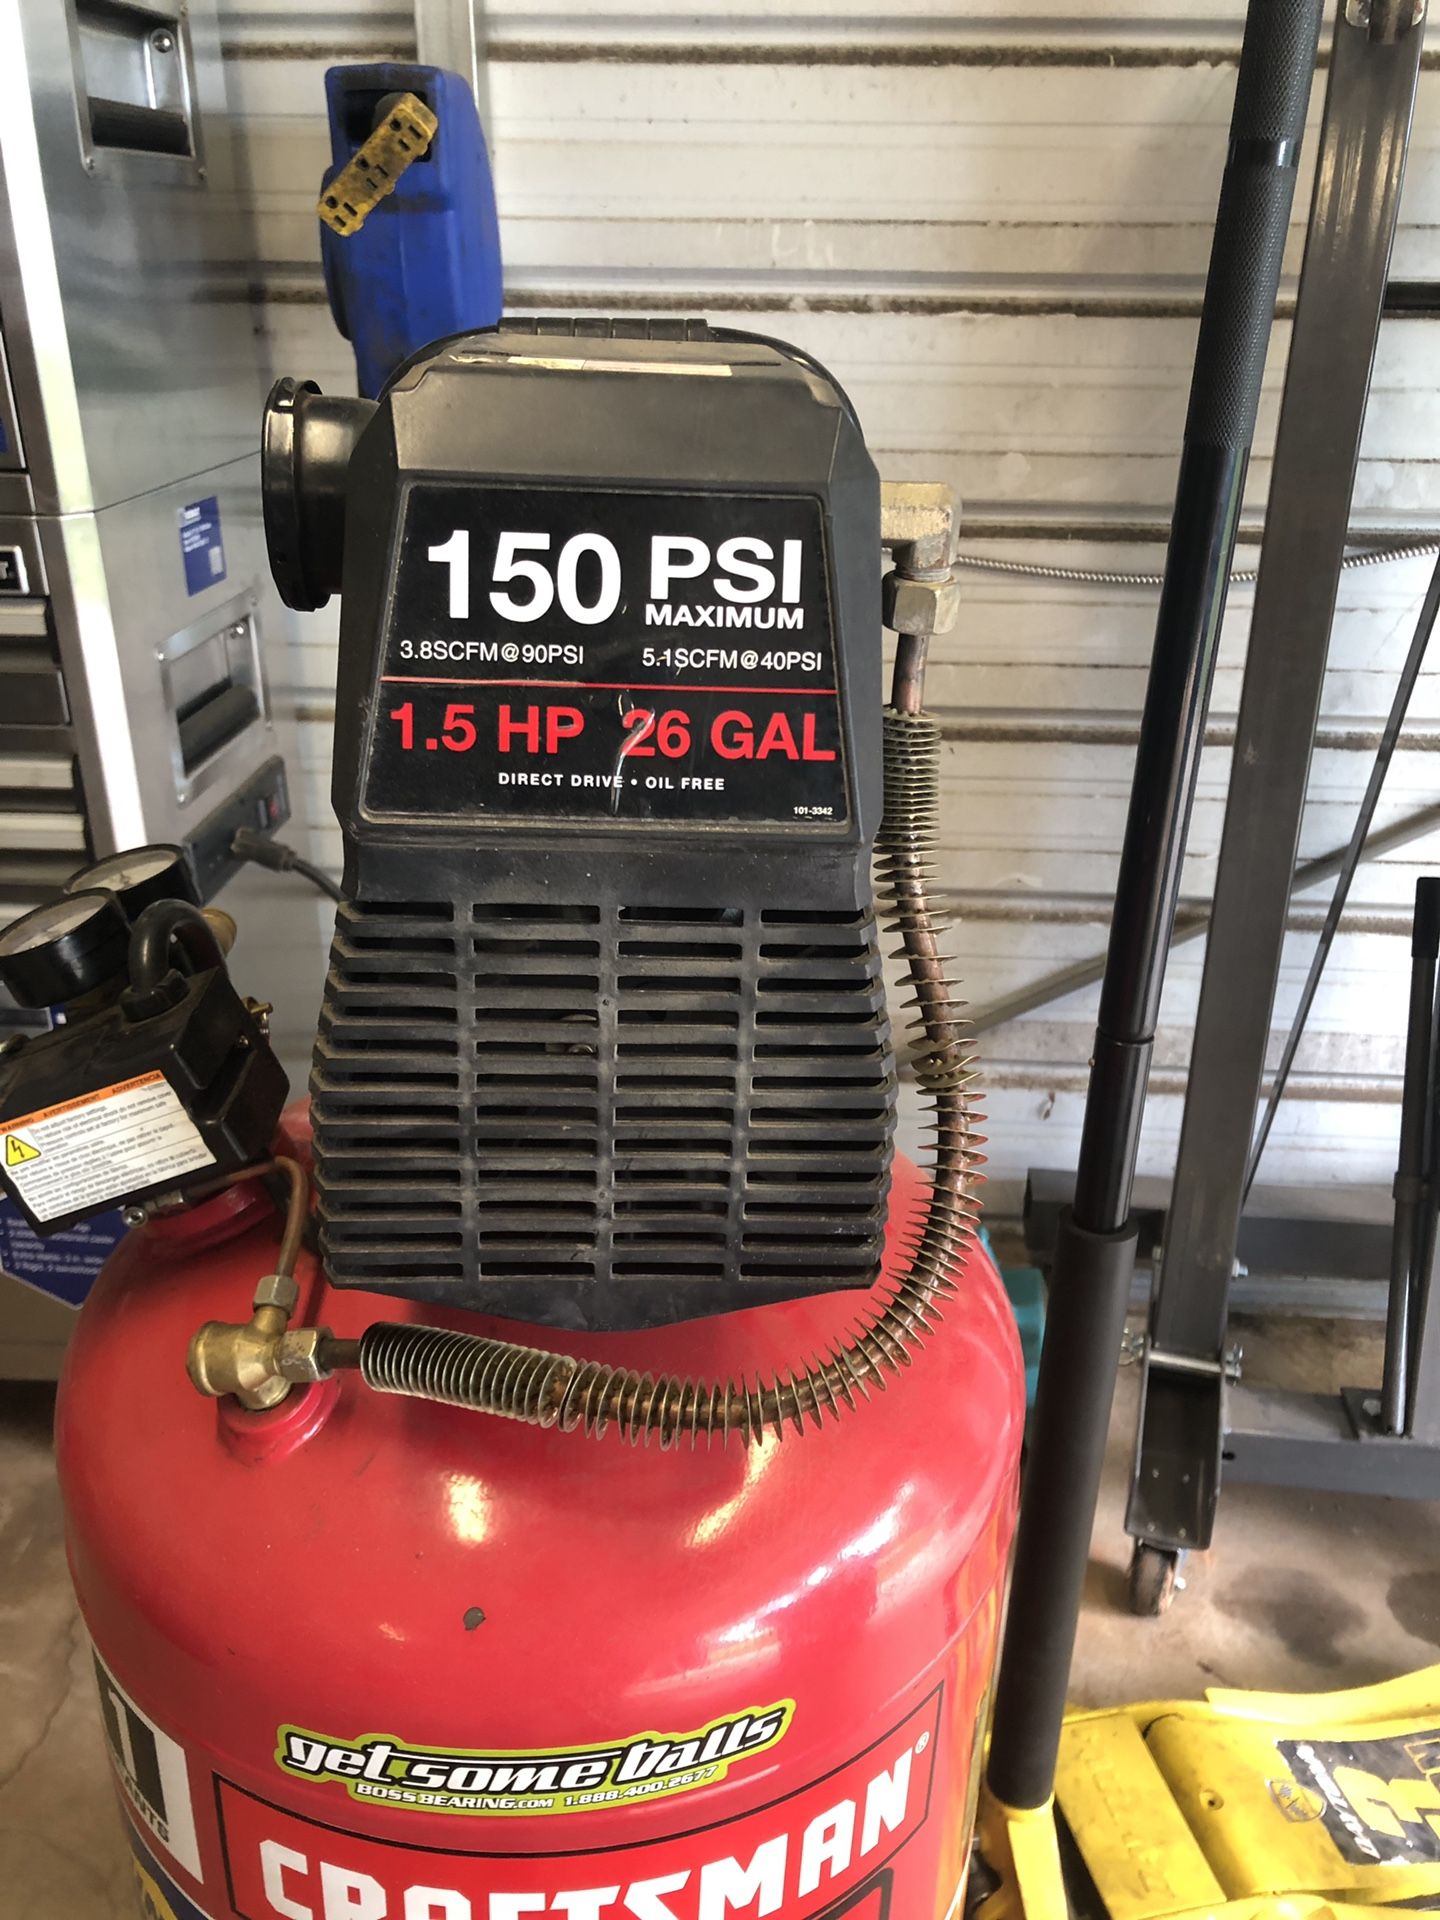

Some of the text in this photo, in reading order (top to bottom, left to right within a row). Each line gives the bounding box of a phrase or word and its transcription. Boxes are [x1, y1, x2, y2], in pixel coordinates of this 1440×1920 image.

[428, 529, 803, 625] 150 PSI
[645, 605, 805, 630] MAXIMUM
[399, 639, 584, 665] 3.8SCFM@90PSI
[642, 648, 822, 672] 5.1SCFM@40PSI
[390, 702, 585, 755] 1.5 HP
[622, 709, 836, 762] 26 GAL
[498, 772, 624, 788] DIRECT DRIVE
[645, 776, 725, 791] OIL FREE
[793, 806, 833, 816] 101-3342
[287, 1710, 784, 1792] get some balls
[564, 1765, 719, 1807] 1.888.400.2677
